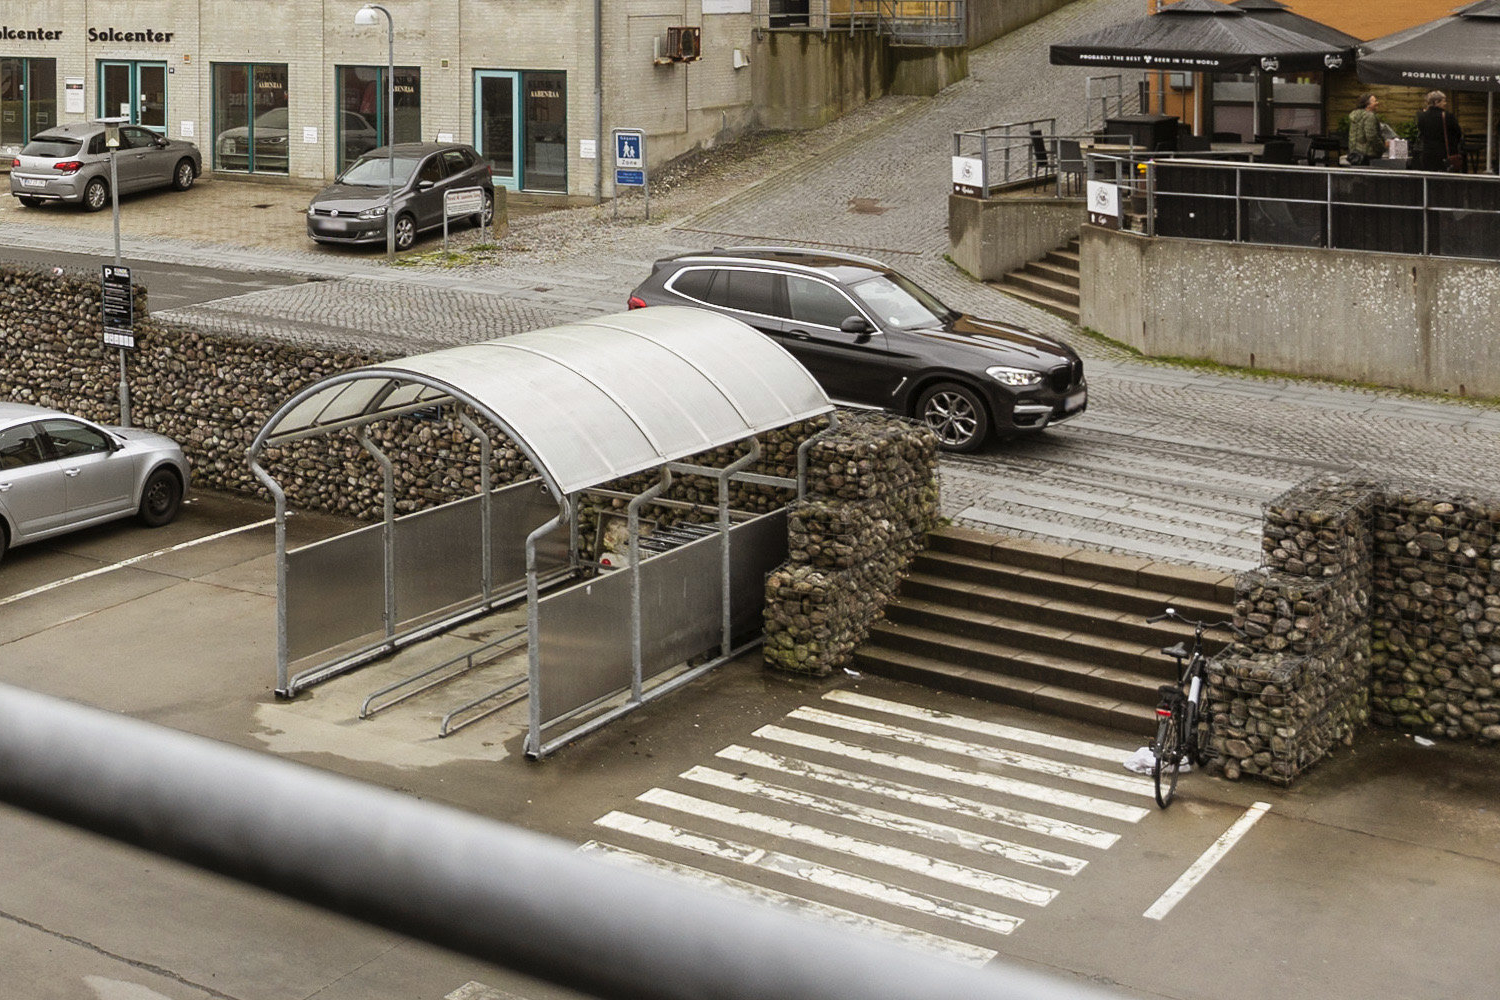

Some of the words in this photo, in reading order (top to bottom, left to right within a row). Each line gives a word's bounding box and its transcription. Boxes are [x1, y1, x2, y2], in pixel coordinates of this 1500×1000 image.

[88, 27, 174, 42] Solcenter
[1402, 71, 1447, 80] PROBABLY
[104, 267, 112, 278] P
